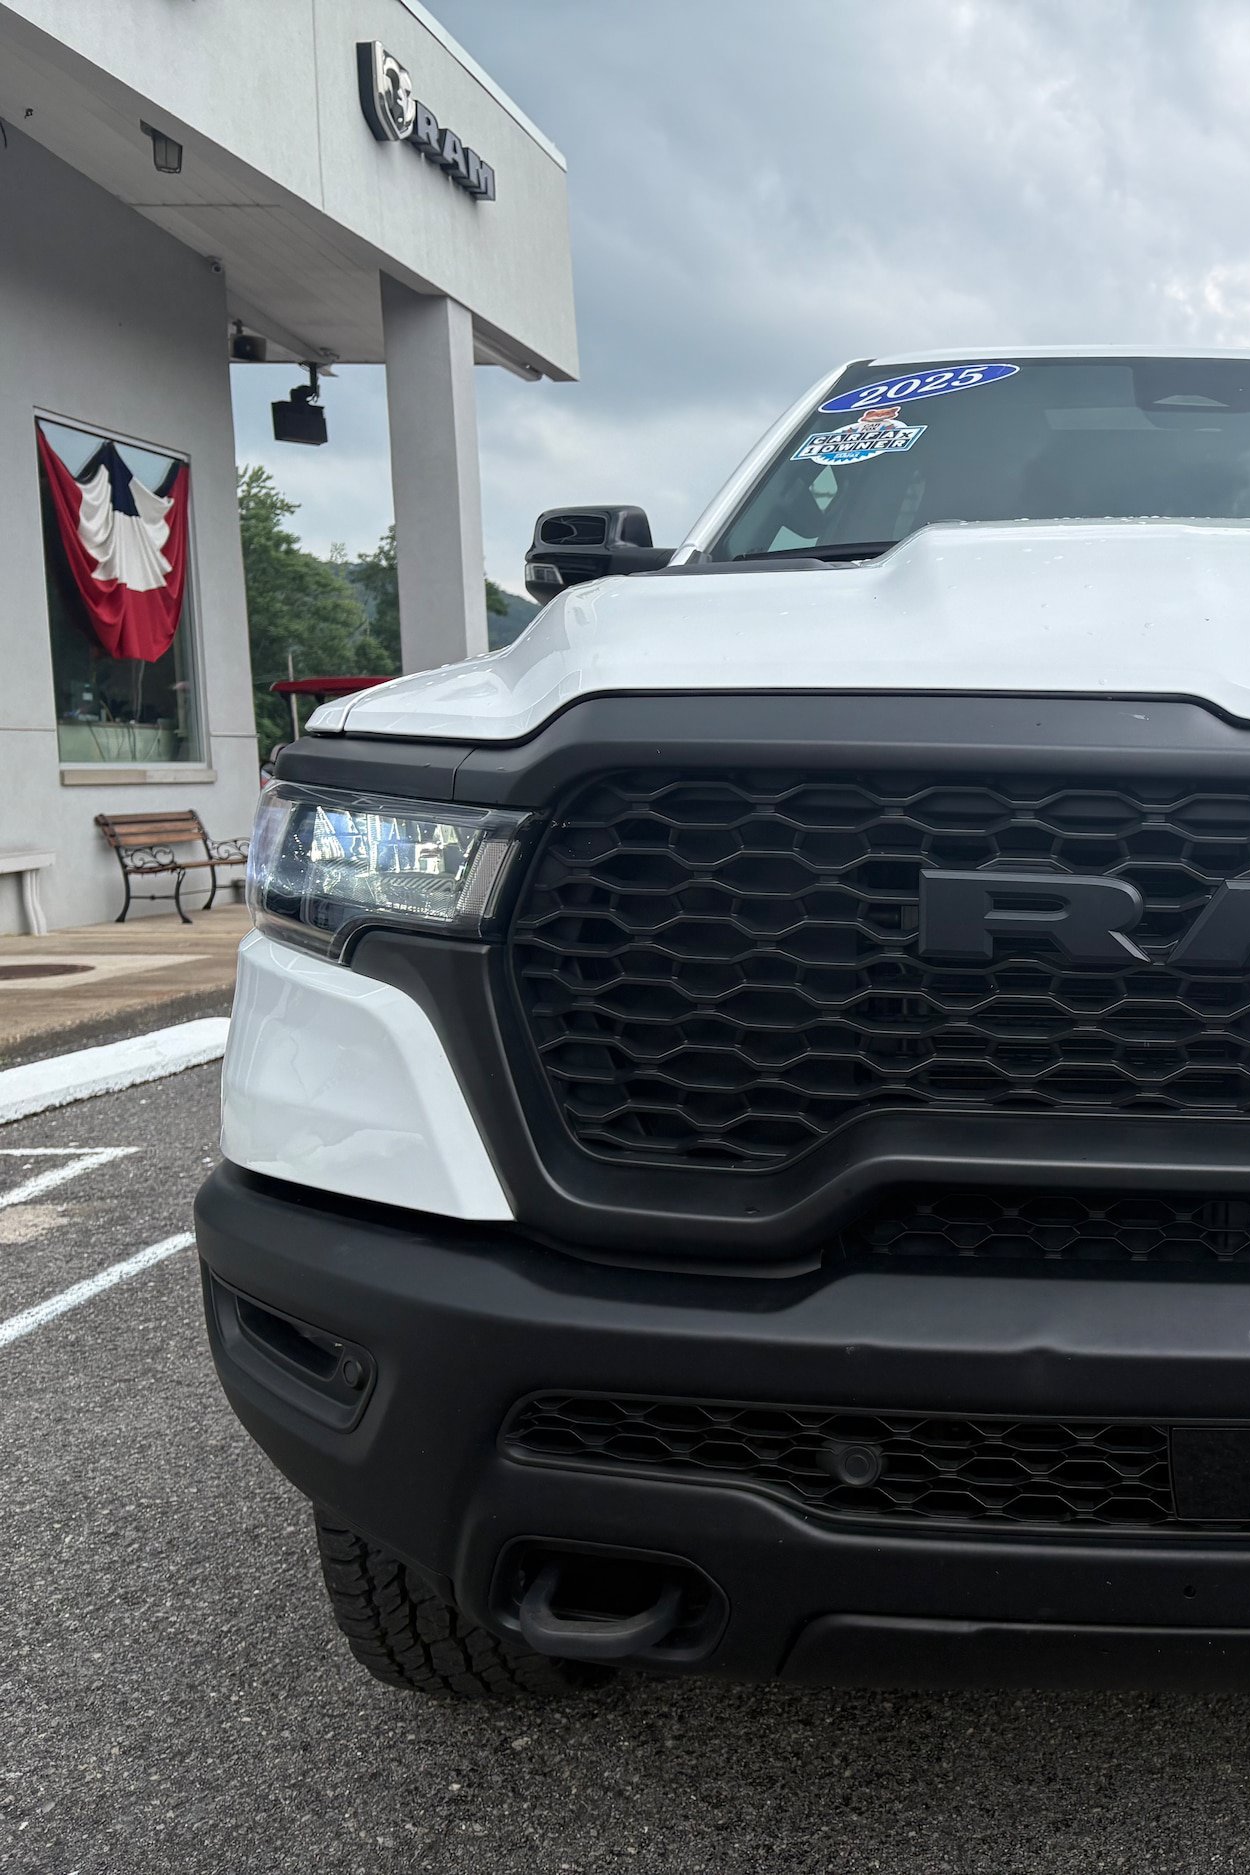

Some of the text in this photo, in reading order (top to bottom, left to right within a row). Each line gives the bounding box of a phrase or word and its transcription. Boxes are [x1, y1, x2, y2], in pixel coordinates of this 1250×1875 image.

[412, 100, 496, 202] RAM
[851, 366, 988, 409] 2025
[813, 430, 913, 445] CARFAX
[821, 440, 905, 453] OWNER
